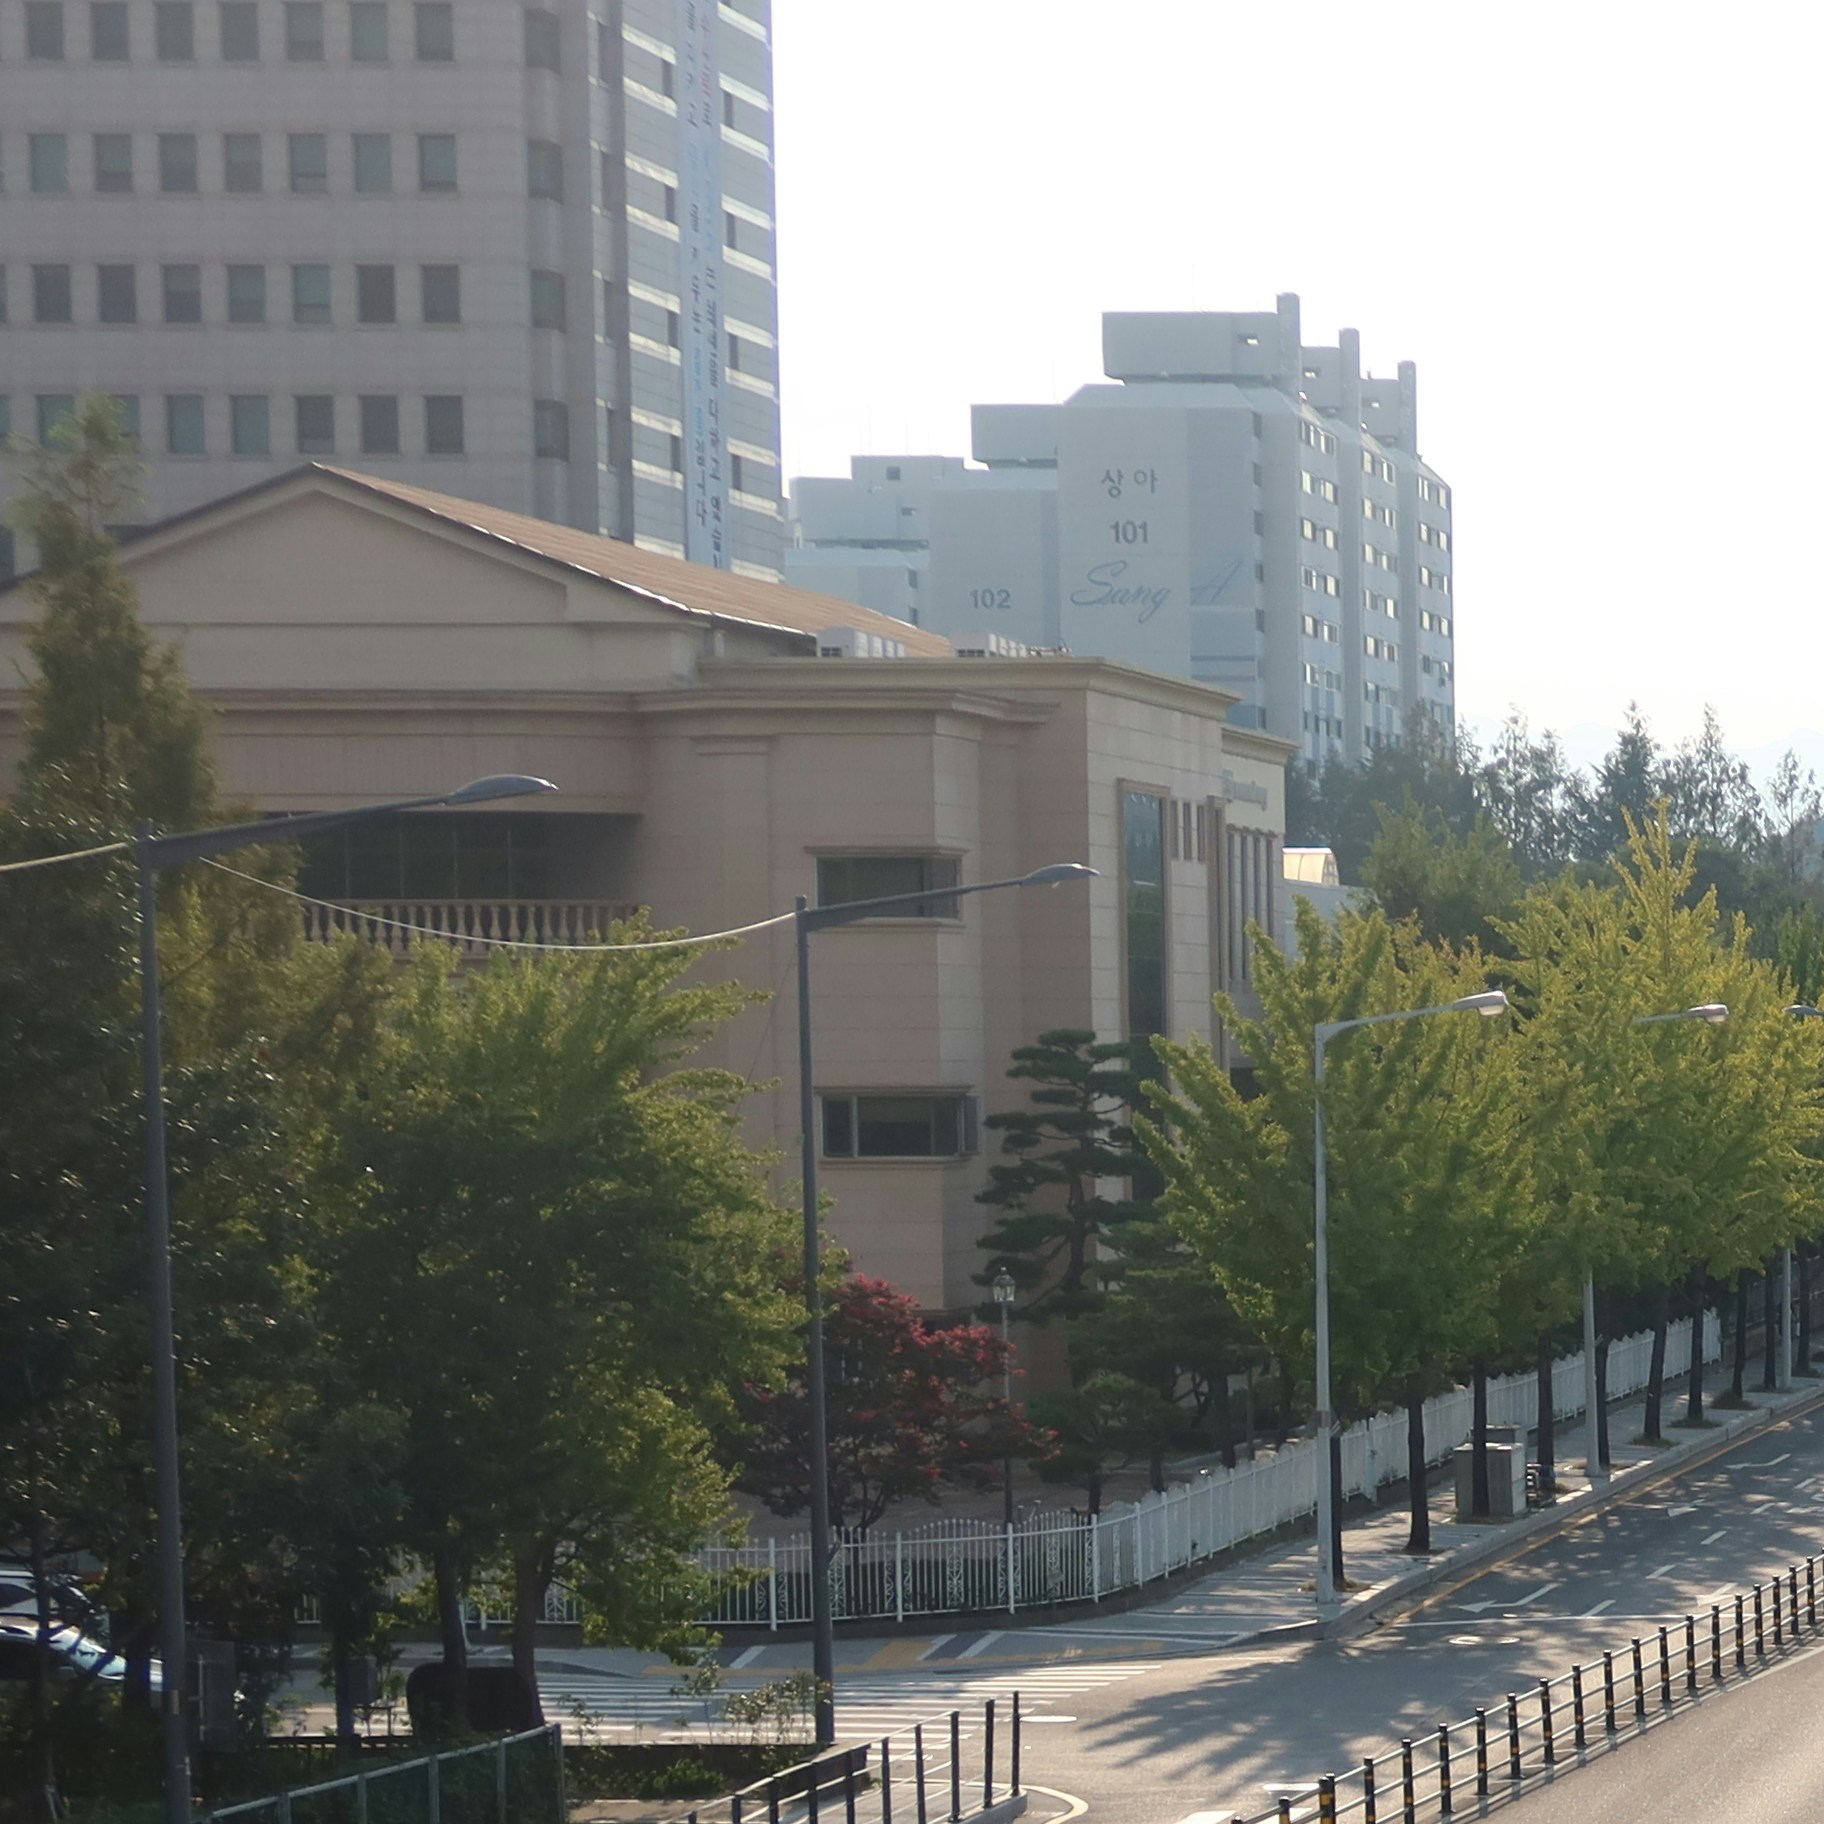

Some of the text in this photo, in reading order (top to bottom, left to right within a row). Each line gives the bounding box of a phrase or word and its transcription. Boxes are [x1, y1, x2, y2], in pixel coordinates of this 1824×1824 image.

[1099, 466, 1159, 498] 상아
[1109, 520, 1150, 545] 101
[969, 588, 1012, 611] 102
[1070, 559, 1171, 625] Sang
